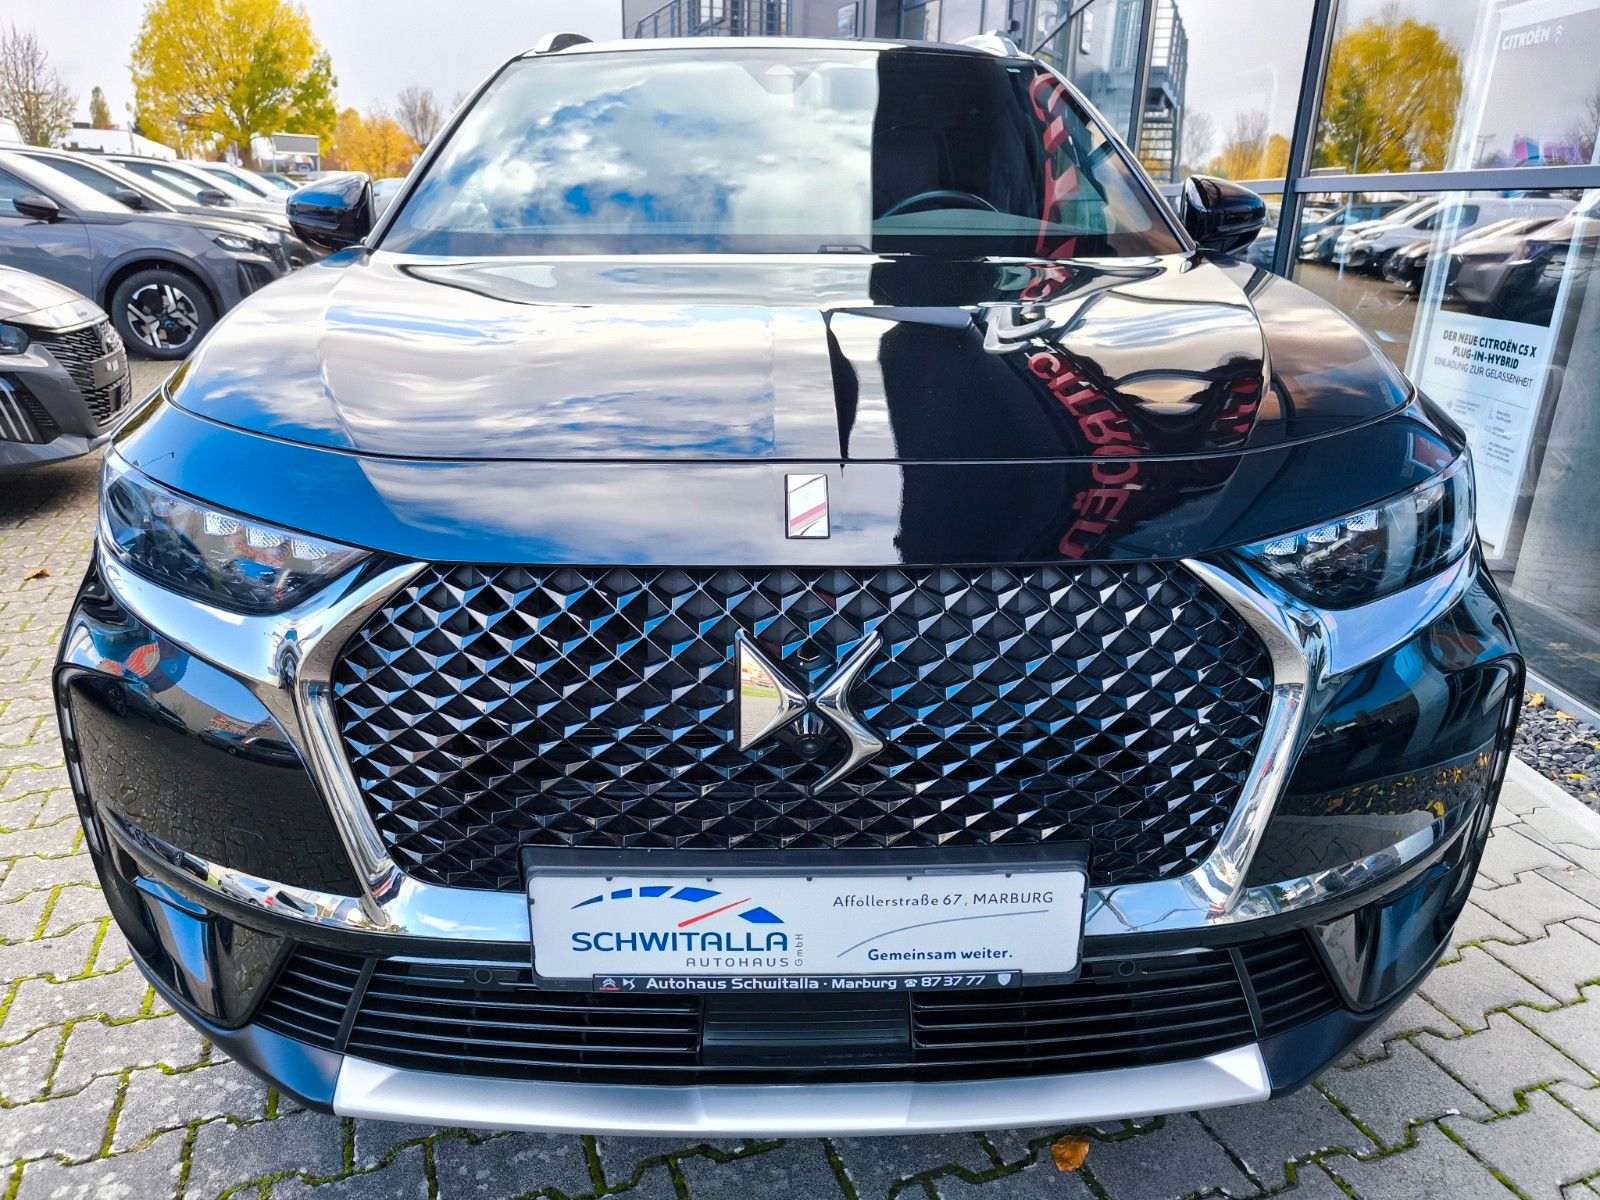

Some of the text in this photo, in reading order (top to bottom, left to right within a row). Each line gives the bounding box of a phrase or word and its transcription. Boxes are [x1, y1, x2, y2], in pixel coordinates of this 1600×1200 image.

[1502, 24, 1551, 49] CITROËN
[1443, 330, 1538, 358] DER NEUE CITROËN C5 X
[1452, 346, 1519, 369] PLUG-IN-HYBRID
[1434, 357, 1533, 388] EINLADUNG ZUR GELASSENHEIT
[833, 894, 939, 907] Afföllerstraße
[973, 891, 1054, 906] MARBURG
[571, 931, 788, 952] SCHWITALLA
[794, 933, 804, 967] GmbH
[686, 957, 789, 968] AUTOHAUS
[867, 947, 1013, 962] Gemeinsam weiter.
[646, 977, 727, 990] Autohaus
[731, 977, 819, 990] Schwitalla
[831, 977, 897, 990] Marburg
